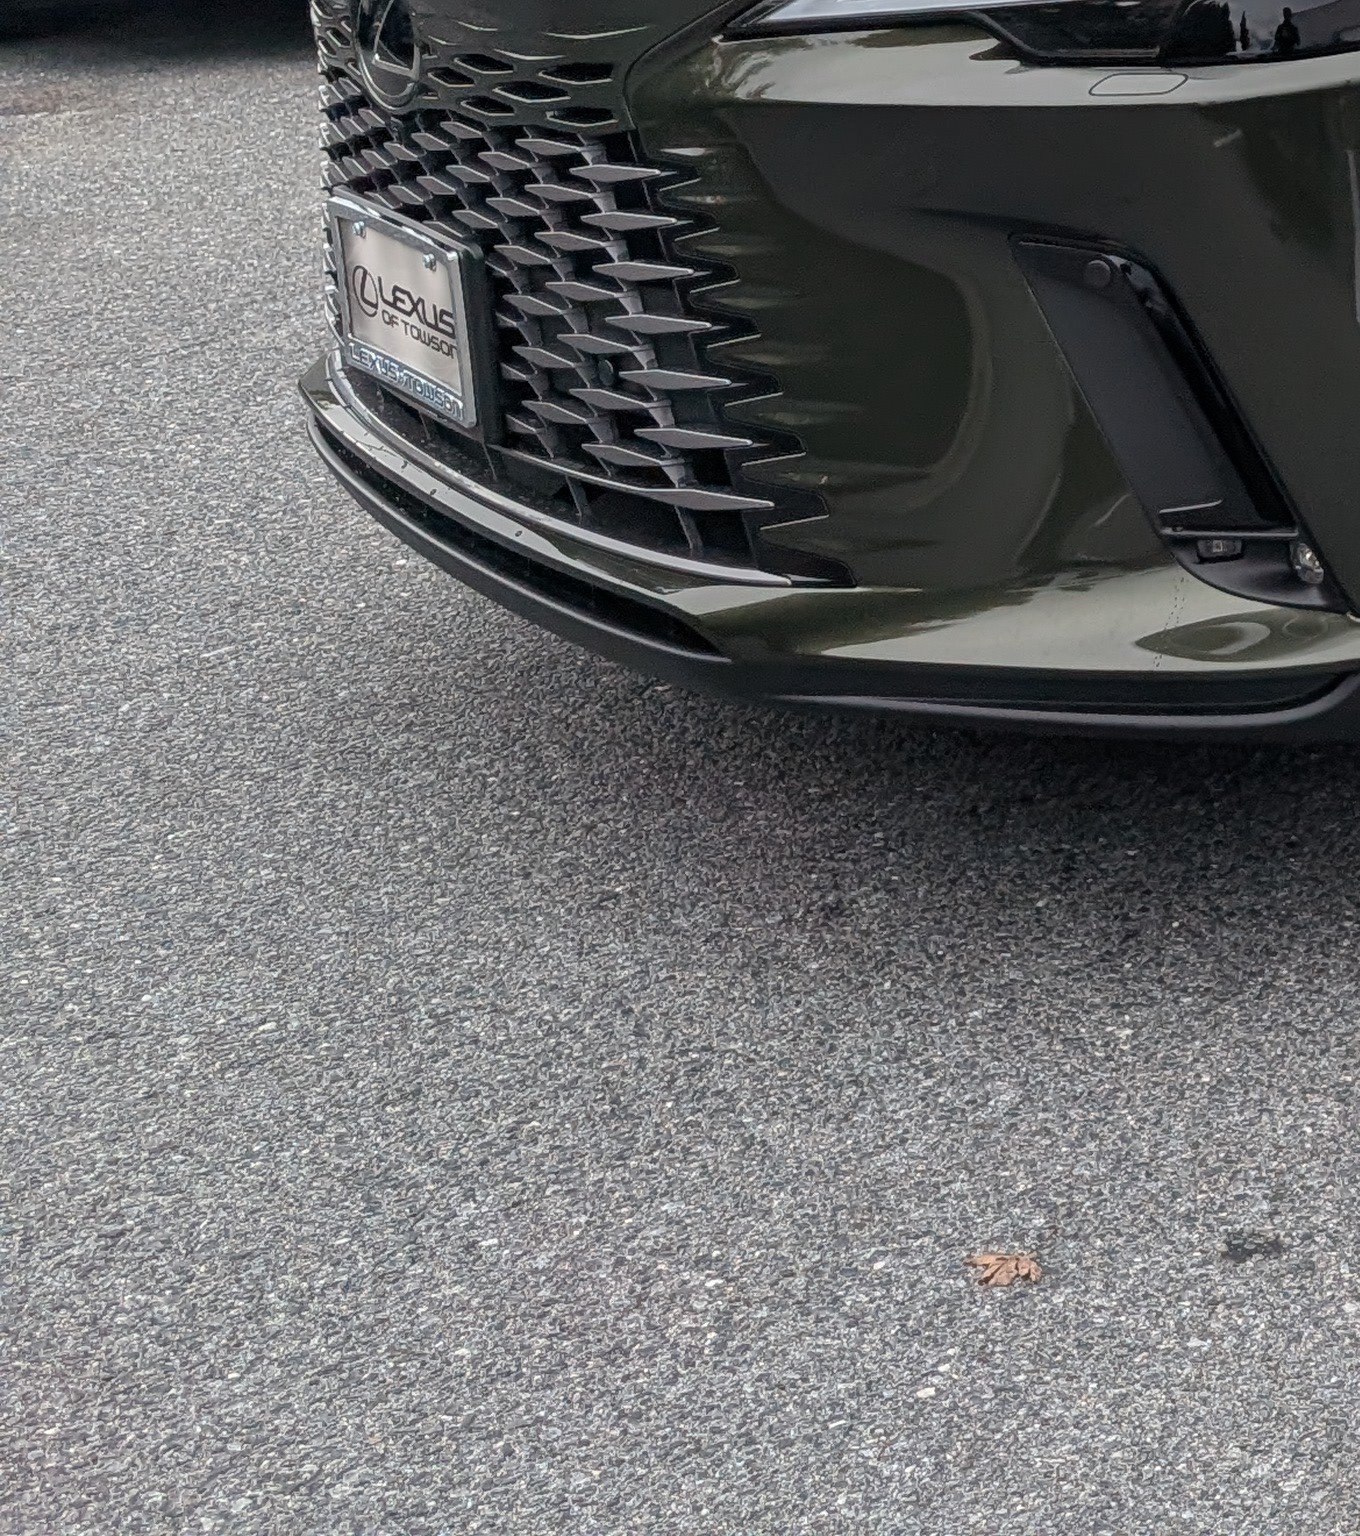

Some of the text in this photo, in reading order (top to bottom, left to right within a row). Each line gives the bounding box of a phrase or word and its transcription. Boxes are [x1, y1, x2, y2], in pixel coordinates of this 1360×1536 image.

[378, 275, 456, 340] LEXUS
[381, 309, 400, 329] OF
[349, 342, 399, 382] LEXUS
